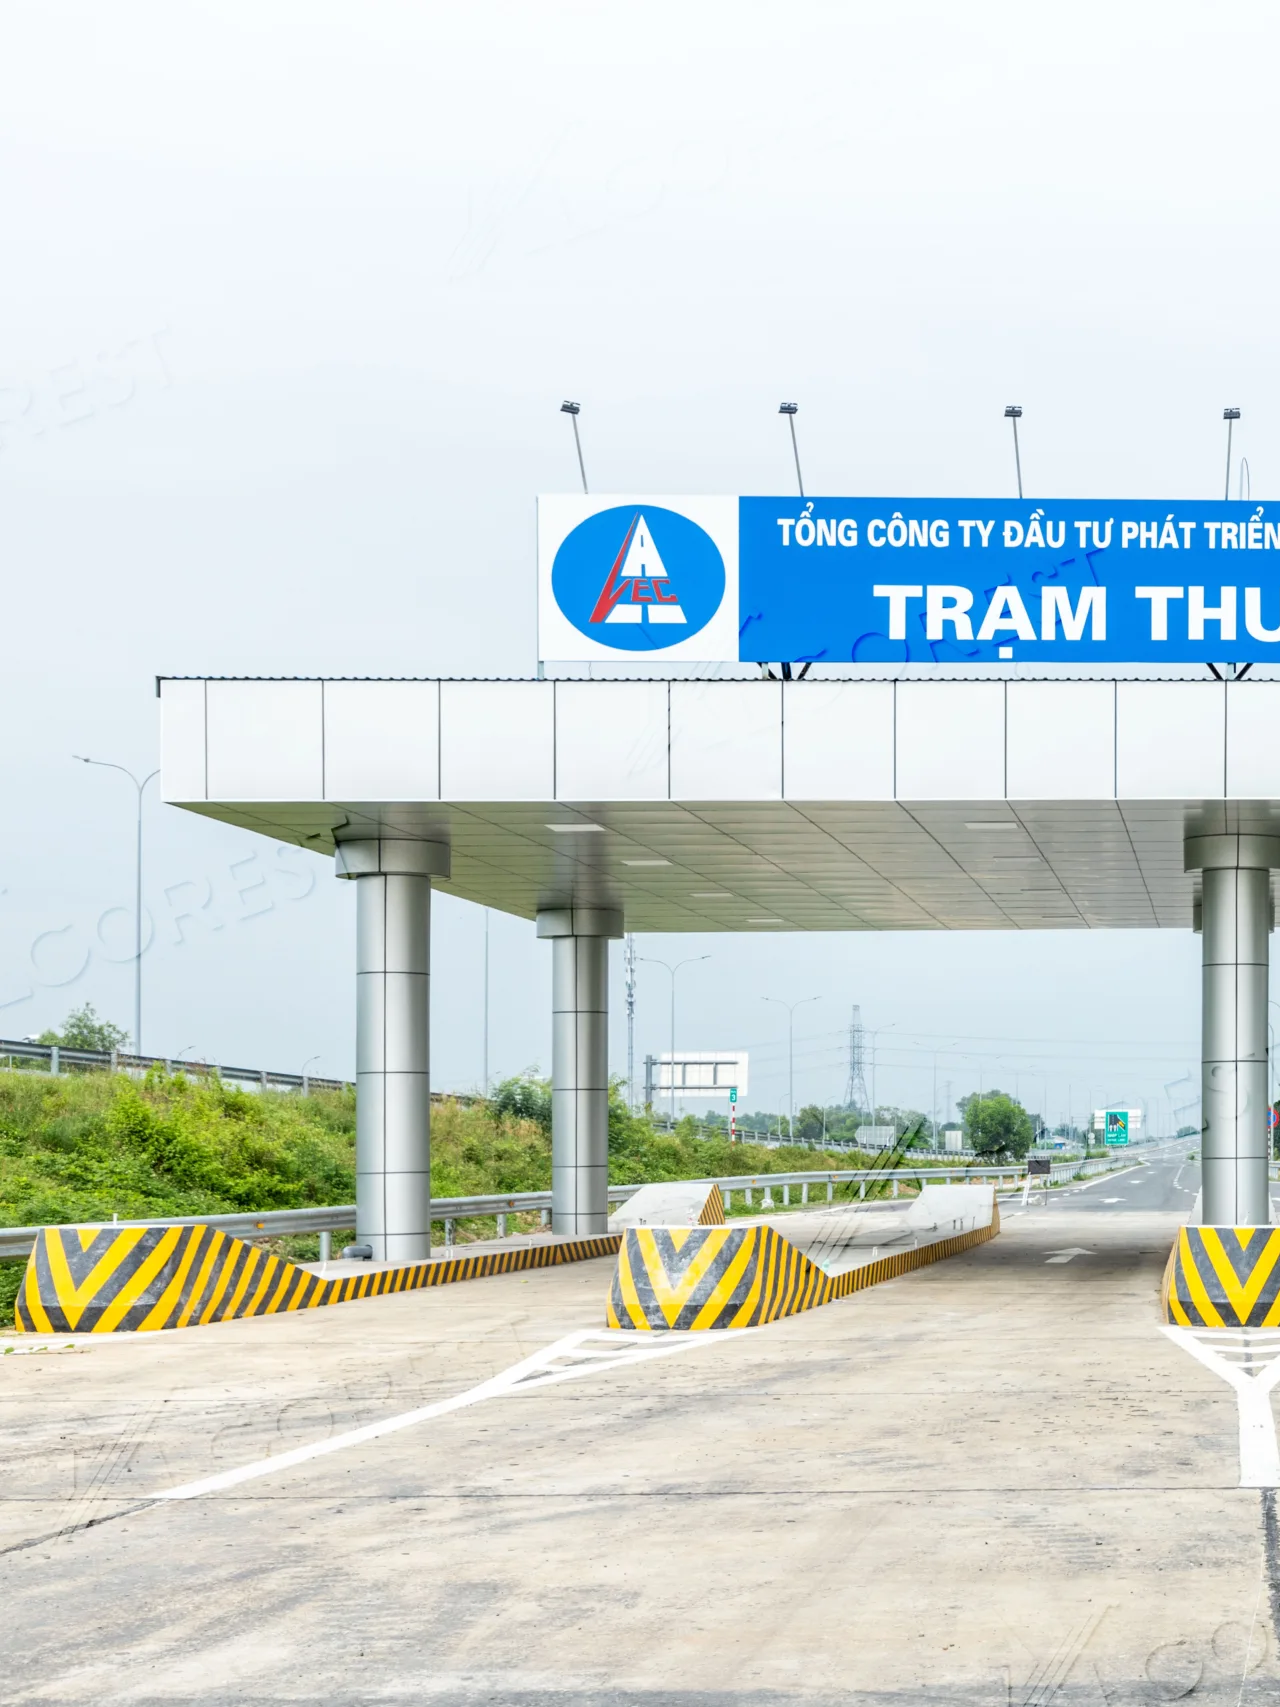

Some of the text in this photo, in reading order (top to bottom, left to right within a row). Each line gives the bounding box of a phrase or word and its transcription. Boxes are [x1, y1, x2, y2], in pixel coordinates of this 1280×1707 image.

[777, 501, 857, 547] TỔNG
[868, 512, 949, 547] CÔNG
[958, 519, 995, 547] TY
[1003, 508, 1065, 548] ĐẦU
[1074, 518, 1113, 548] TƯ
[1122, 514, 1196, 549] PHÁT
[873, 585, 1107, 659] TRẠM
